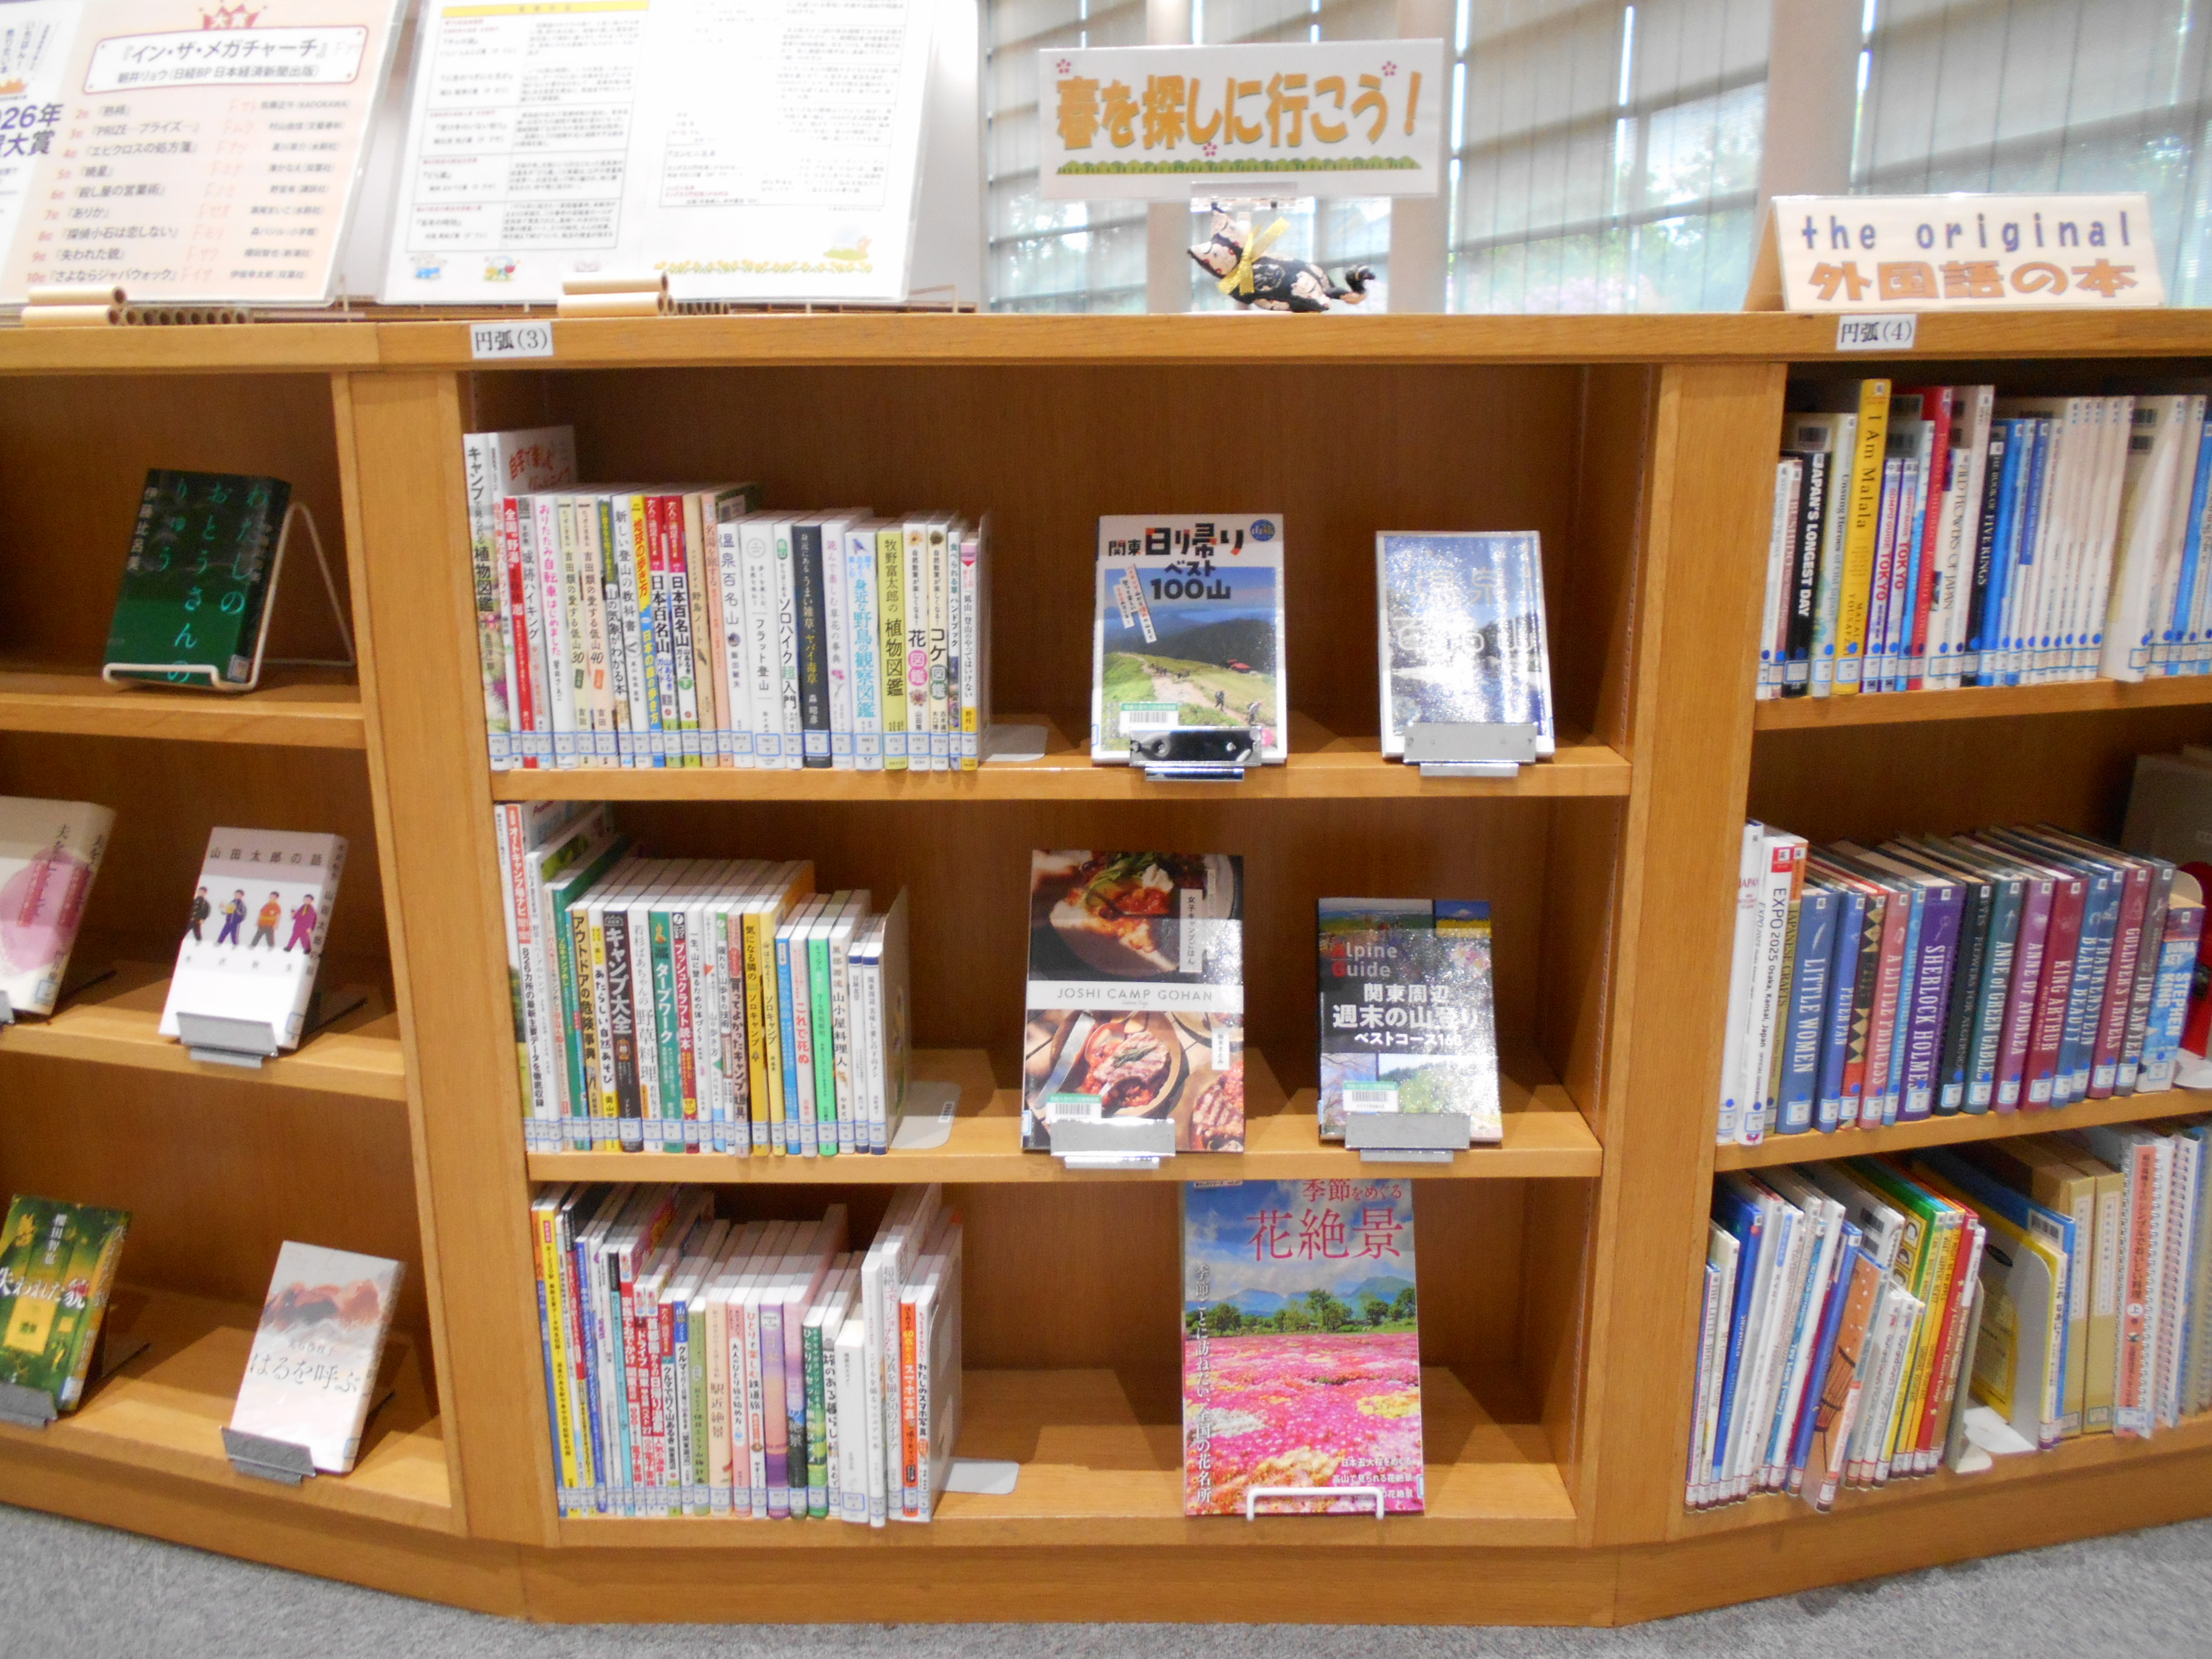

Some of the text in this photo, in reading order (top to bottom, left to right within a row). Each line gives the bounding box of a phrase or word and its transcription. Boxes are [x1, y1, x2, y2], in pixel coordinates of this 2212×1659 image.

[0, 103, 63, 130] 26年
[1057, 71, 1422, 149] 春を探しに行こう！
[1802, 211, 2131, 252] the original
[1808, 258, 2139, 301] 外国語の本
[475, 328, 548, 352] 円弧(3)
[1840, 320, 1912, 344] 円弧(4)
[1864, 429, 1881, 459] Am
[1856, 468, 1877, 529] Malala
[615, 511, 637, 632] 新しい登山の教科書
[1108, 522, 1244, 558] 関東 日帰り
[1164, 560, 1216, 577] ベスト
[1798, 464, 1825, 617] JAPAN'S LONGEST DAY
[1895, 541, 1909, 590] TOKYO
[1978, 546, 1991, 585] RINGS
[540, 504, 561, 655] おりたたみ自転車はじめました
[719, 533, 739, 625] 温泉百名山
[1150, 578, 1232, 600] 100山
[1876, 552, 1892, 601] TOKYO
[651, 575, 670, 654] 日本百名山
[672, 576, 689, 647] 日本百名山
[884, 540, 905, 697] 牧野富太郎の植物図鑑
[756, 618, 770, 691] フラット登山
[779, 599, 797, 709] ソロハイク超入門
[853, 578, 876, 718] 身近な野鳥の観察図鑑
[908, 629, 928, 686] 花図鑑
[930, 628, 948, 700] コケ図鑑
[210, 846, 323, 866] 山田太郎の話
[1187, 896, 1195, 965] 女子キャンプごはん
[1770, 888, 1786, 929] EXPO
[1332, 942, 1398, 961] Alpine
[1332, 960, 1391, 977] Guide
[1767, 931, 1781, 962] 2025
[1991, 941, 2014, 974] ANNE
[572, 916, 596, 1059] アウトドアの危険事典
[605, 929, 632, 1034] キャンプ大全
[656, 963, 674, 1044] タープワーク
[674, 943, 692, 1049] ブッシュクラフト読本
[689, 933, 703, 1042] 一生、山に登るための体づくり
[1057, 987, 1213, 1001] JOSHI CAMP GOHAN
[1364, 984, 1450, 1004] 関東周辺
[1880, 965, 1902, 1016] LITTLE
[1915, 945, 1946, 1025] SHERLOCK
[1983, 992, 2006, 1031] GREEN
[2011, 942, 2044, 1056] ANNE AVONLEA
[2040, 960, 2072, 1051] KING ARTHUR
[2064, 936, 2098, 1042] BLACK BEAUTY
[2080, 937, 2114, 1045] FRANKENSTEIN
[2106, 927, 2142, 1050] GULLIVER'S TRAVELS
[2155, 972, 2193, 1037] STEPHEN KING
[595, 970, 613, 1083] あたらしい自然あそび
[766, 996, 777, 1045] ソロキャンプ
[796, 1002, 810, 1064] これで死ぬ
[1333, 1005, 1478, 1029] 週末の山登り
[1759, 1024, 1770, 1048] Japan
[1793, 957, 1826, 1074] LITTLE WOMEN
[1834, 987, 1854, 1045] PETER PAN
[2125, 973, 2156, 1057] TOM SAWYER
[730, 977, 746, 1119] 買ってよかったキャンプ道具
[1872, 1019, 1895, 1085] PRINCESS
[1302, 1178, 1403, 1202] 季節をめぐる
[1245, 1207, 1403, 1261] 花絶景
[249, 1352, 361, 1393] はるを呼ぶ
[731, 1342, 743, 1425] 大人のひとり旅の始め方
[747, 1312, 761, 1410] ひとりで楽しむ鉄道旅
[1195, 1264, 1212, 1503] 季節ごとに訪ねたい、全国の花名所
[918, 1363, 928, 1436] わたしのスマホ写真
